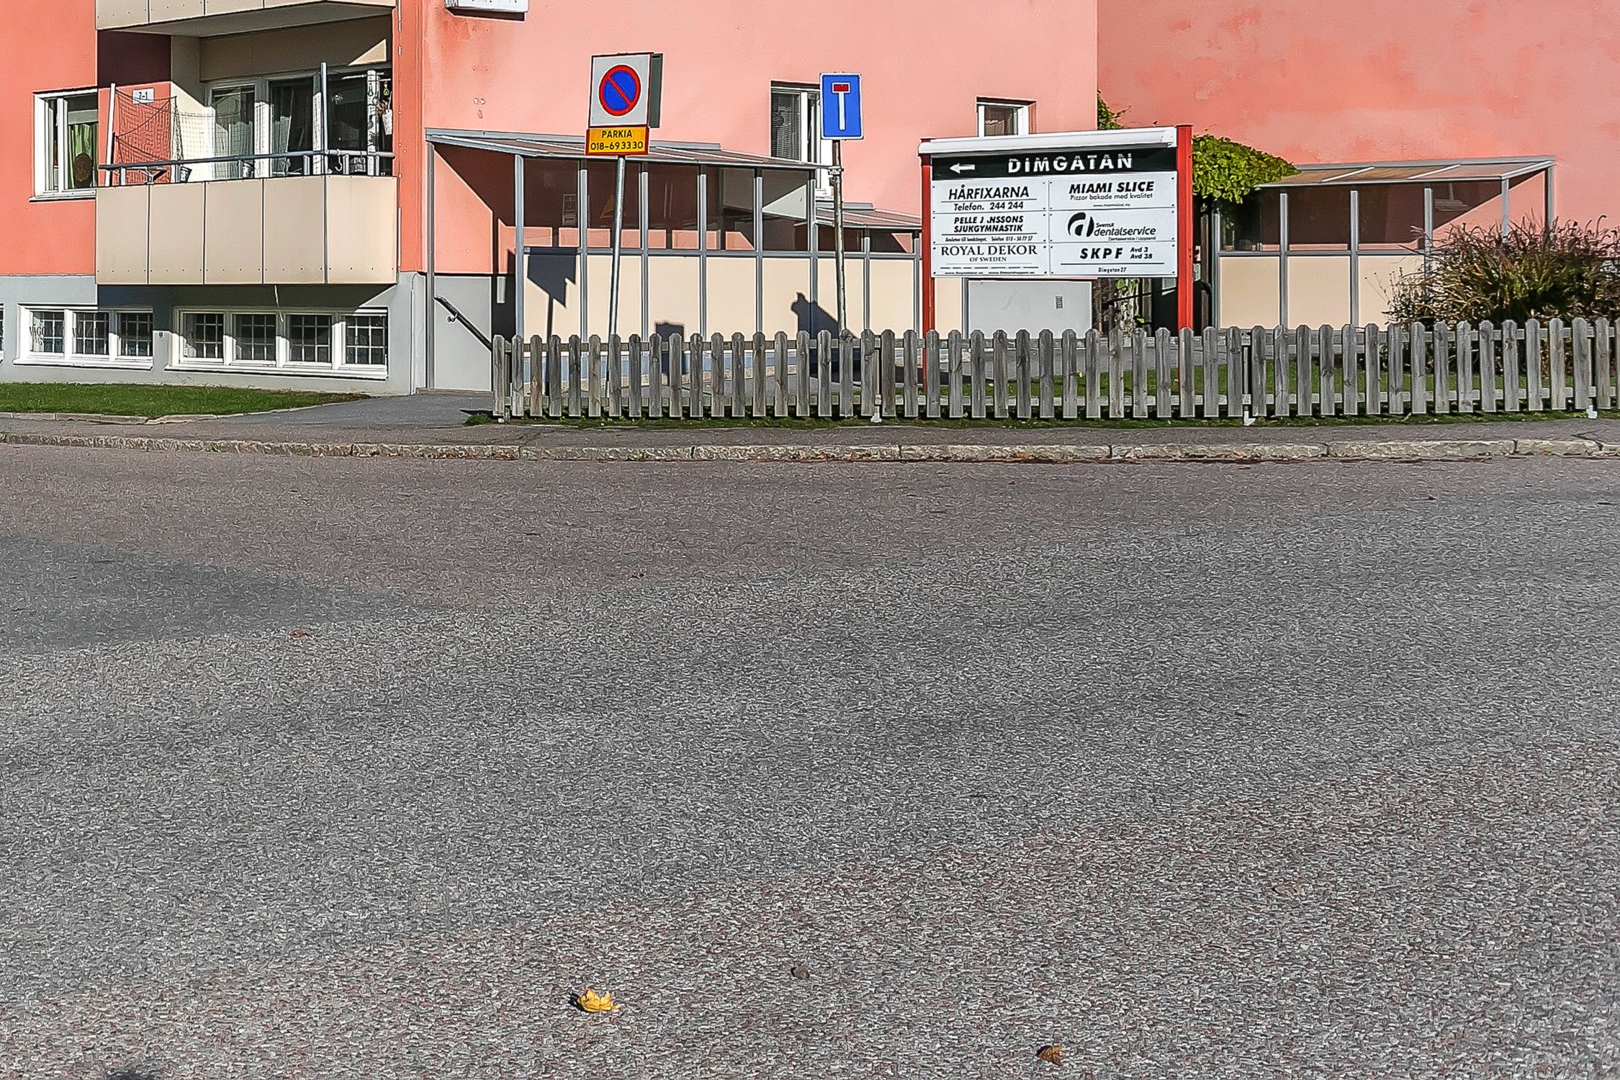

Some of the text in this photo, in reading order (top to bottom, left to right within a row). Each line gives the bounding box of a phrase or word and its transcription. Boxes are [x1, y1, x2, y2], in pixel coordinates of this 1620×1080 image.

[601, 129, 633, 139] PARKIA
[1007, 152, 1133, 174] DIMGATAN
[948, 184, 1030, 200] HÅRFIXARNA
[1069, 181, 1155, 194] MIAMI SLICE
[989, 202, 1006, 211] 244
[1008, 201, 1024, 210] 244
[954, 216, 978, 225] PELLE
[953, 224, 1024, 233] SJUKGYMNASTIK
[1093, 226, 1156, 237] dentalservice
[941, 245, 1038, 256] ROYAL DEKOR
